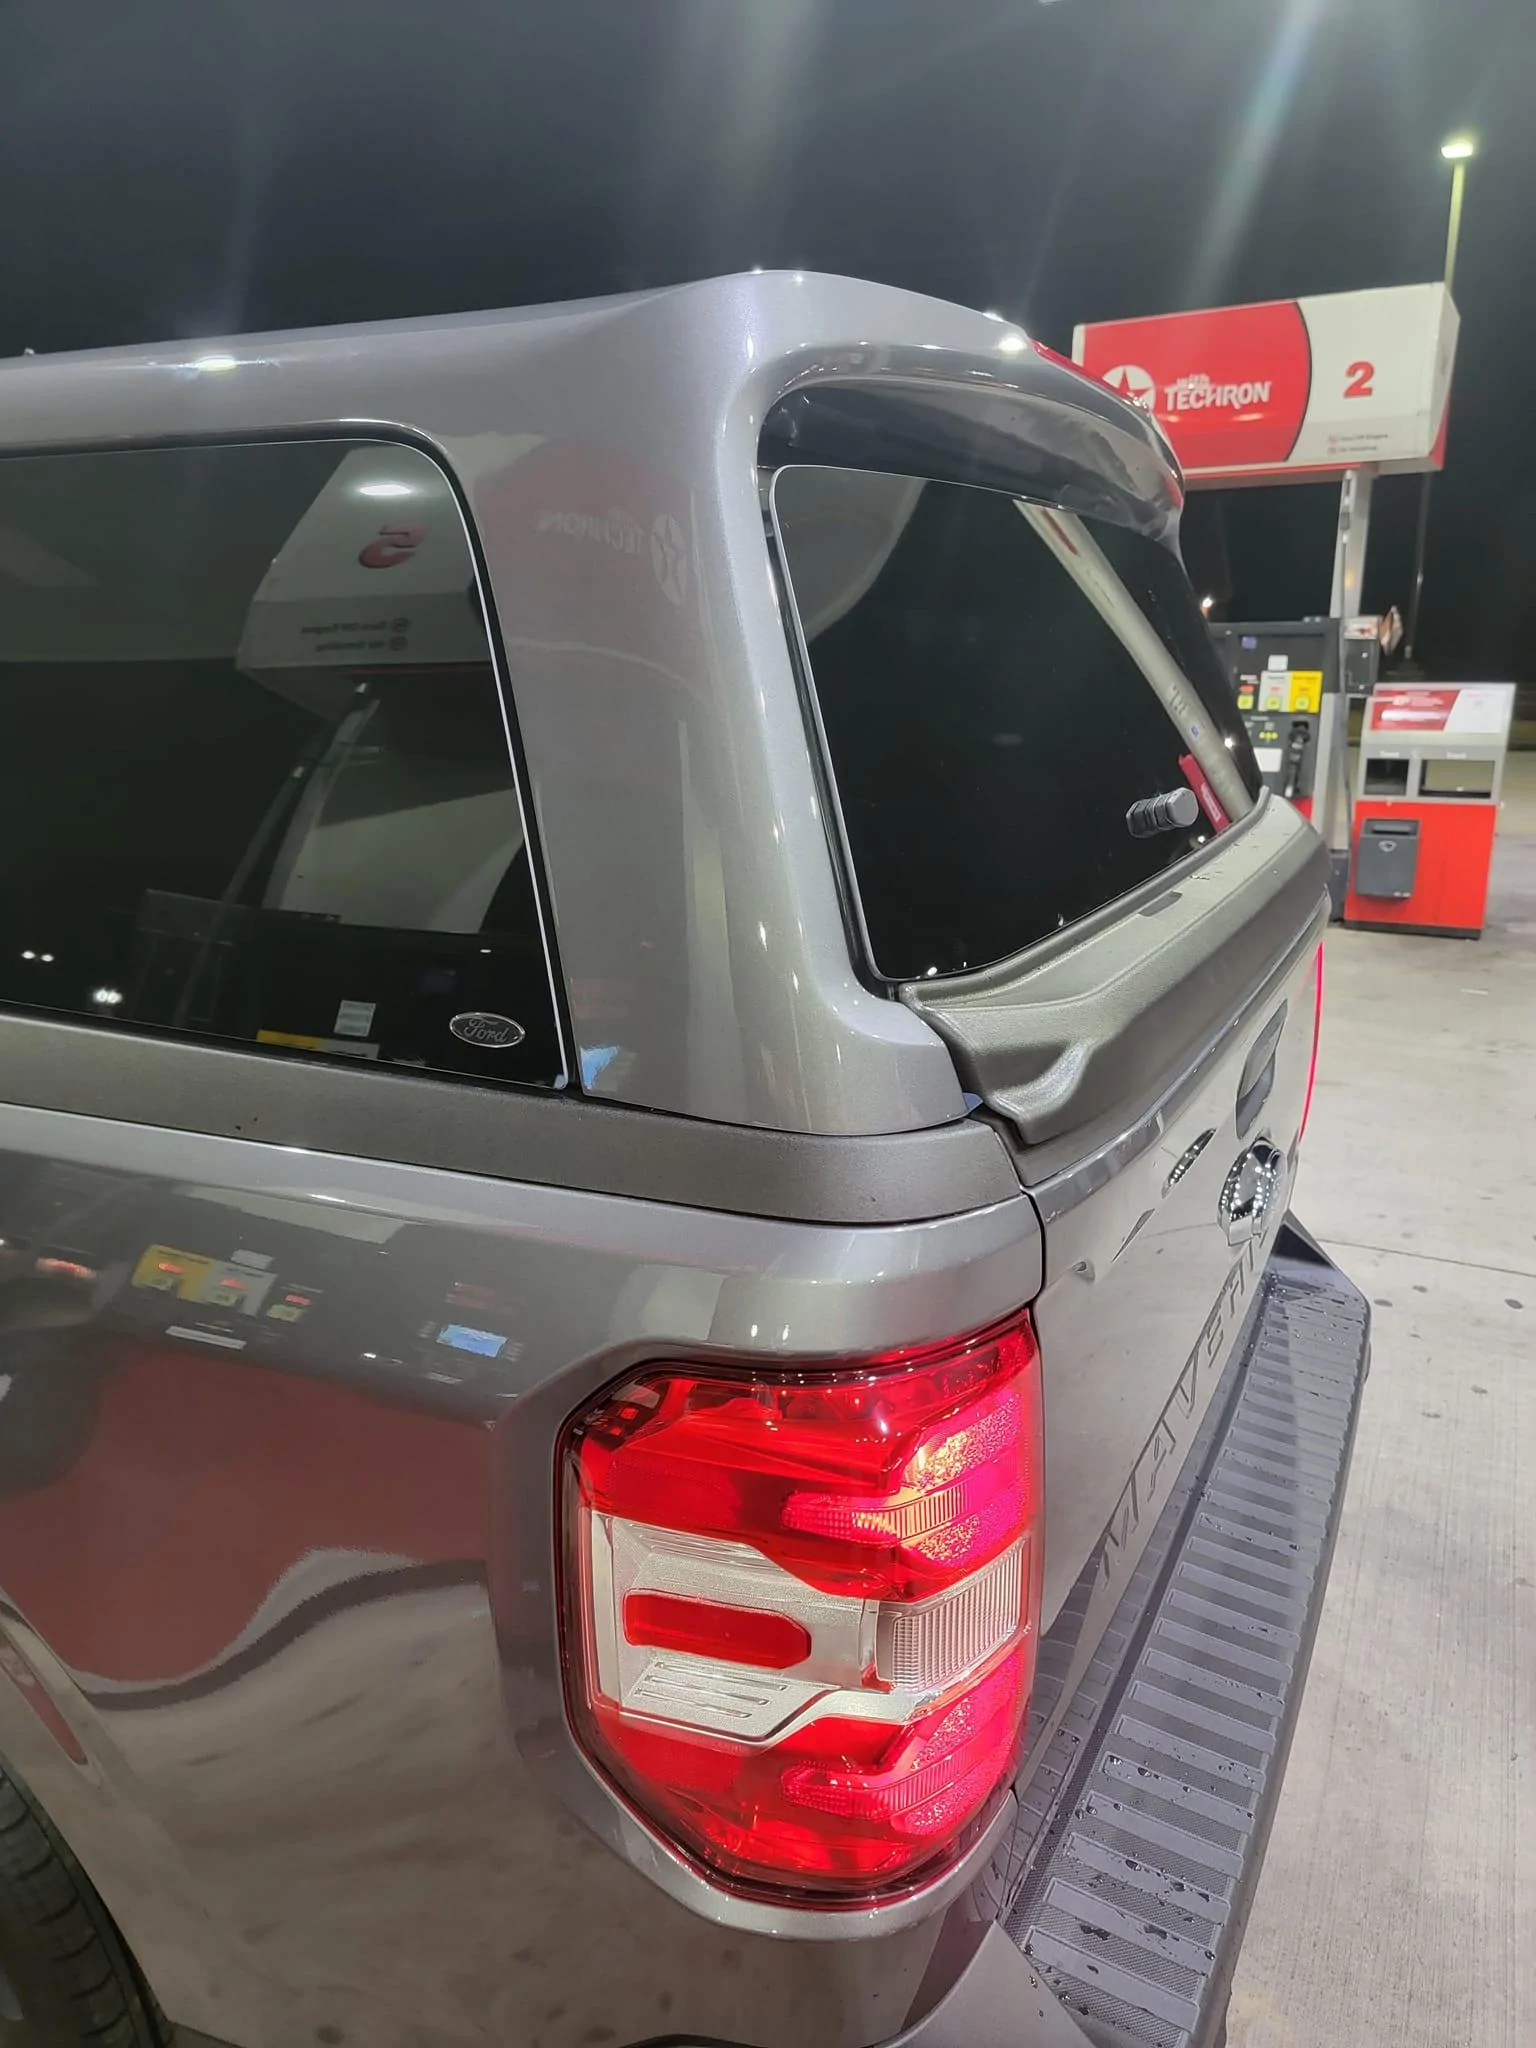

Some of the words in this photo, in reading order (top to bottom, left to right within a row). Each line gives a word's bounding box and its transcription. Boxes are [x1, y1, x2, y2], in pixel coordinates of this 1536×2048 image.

[1164, 381, 1272, 412] TECHRON
[1343, 360, 1375, 399] 2
[464, 1018, 510, 1043] Ford
[1099, 1226, 1269, 1590] MAVERI
